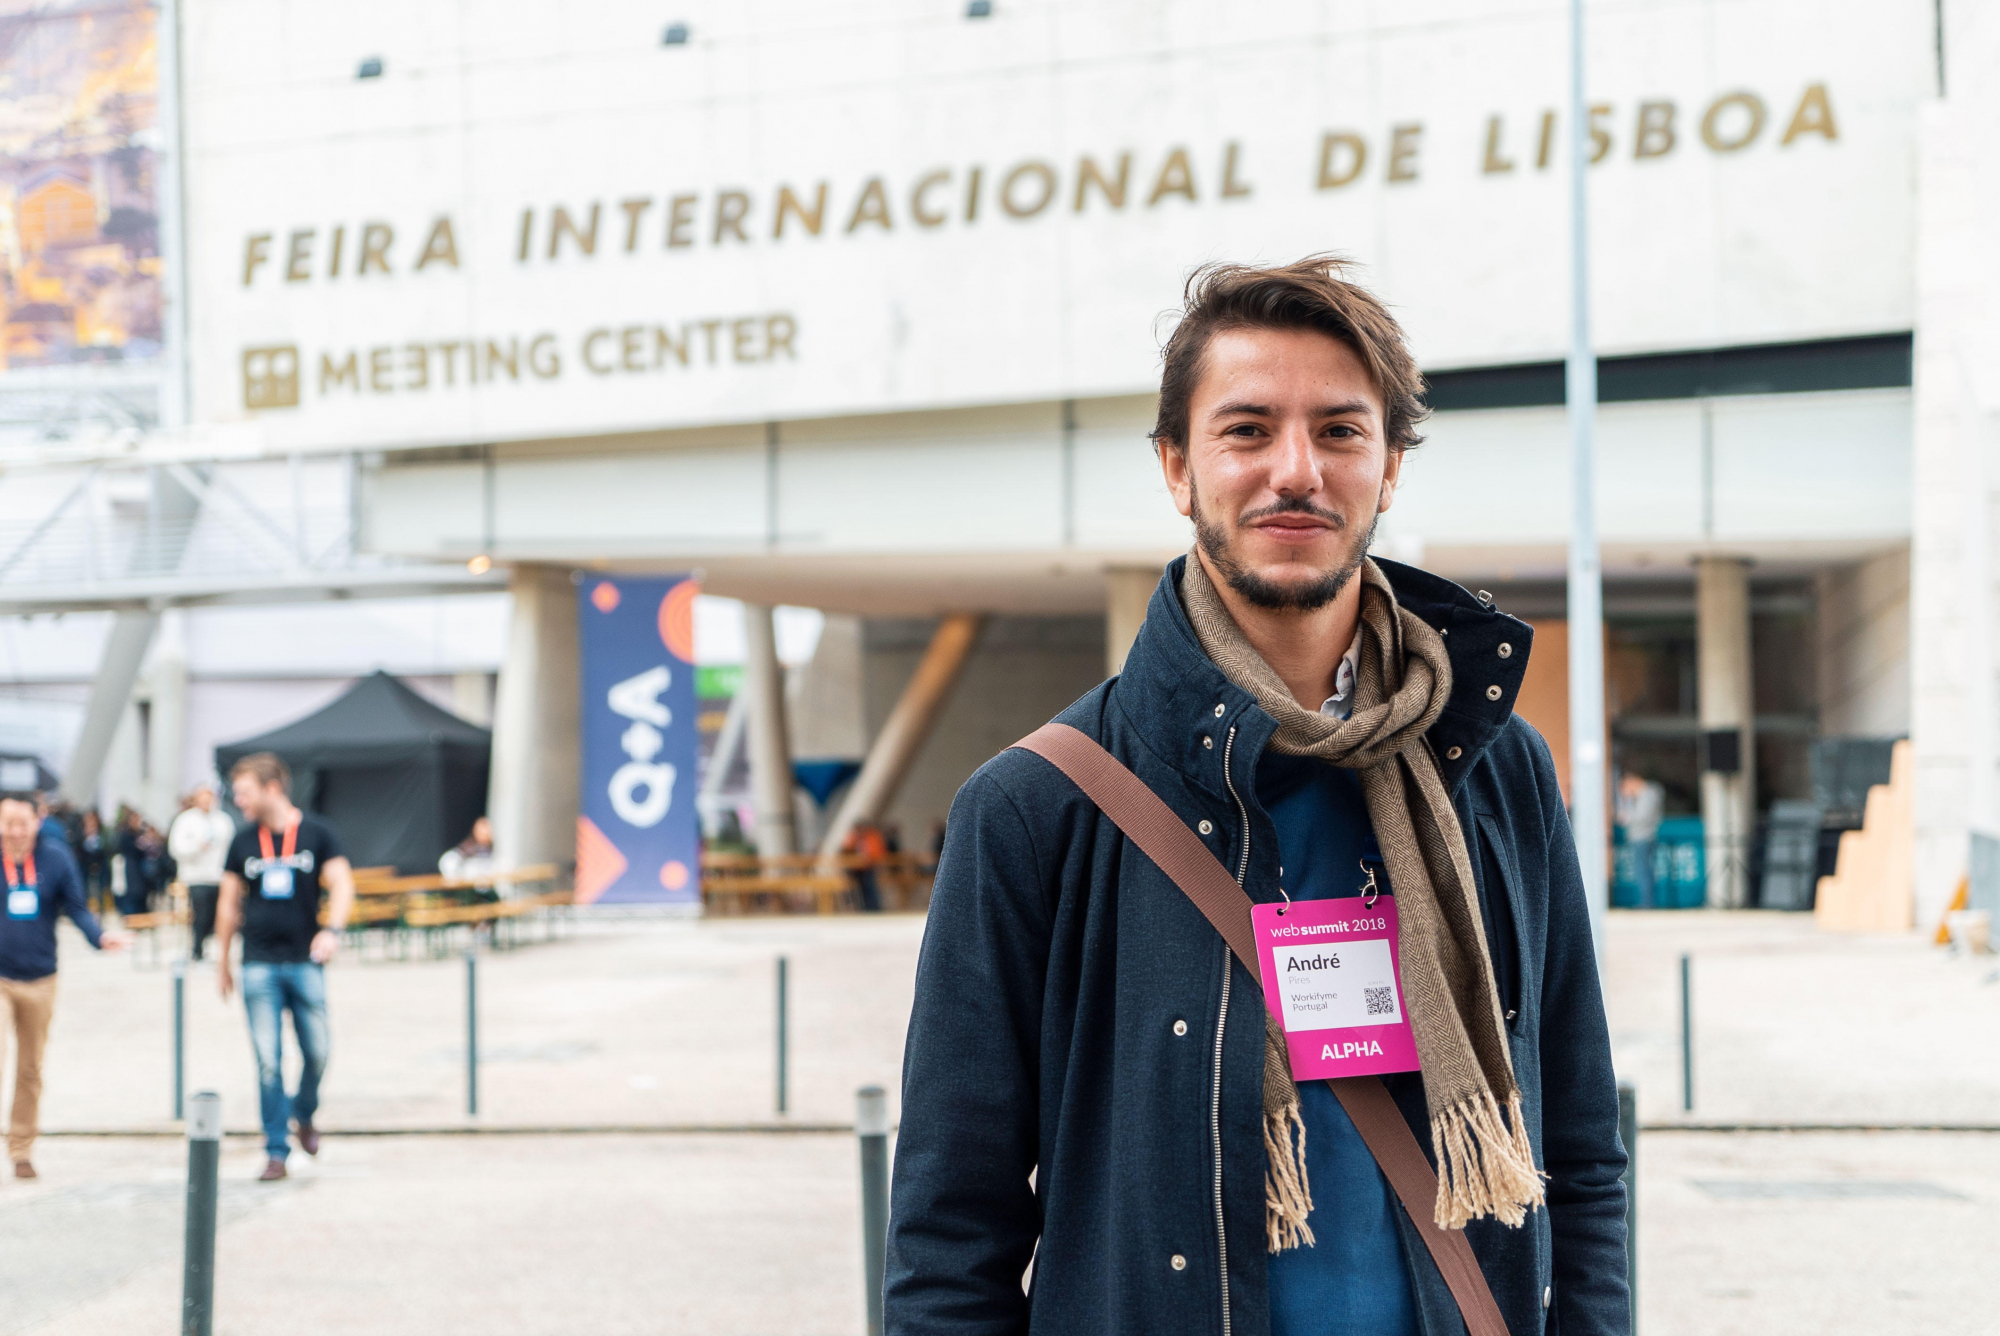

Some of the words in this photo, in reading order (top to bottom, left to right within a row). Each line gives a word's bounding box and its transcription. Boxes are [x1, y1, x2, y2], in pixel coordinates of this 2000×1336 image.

[243, 214, 460, 286] FEIRA
[517, 139, 1254, 263] INTERNACIONAL
[1315, 123, 1424, 190] DE
[1481, 83, 1839, 175] LISBOA
[580, 313, 799, 376] CENTER
[1352, 917, 1387, 932] 2018
[1287, 953, 1341, 972] André
[1288, 976, 1311, 985] Pires
[1291, 992, 1338, 1002] Workifyme
[1292, 1001, 1328, 1012] Portugal
[1321, 1040, 1383, 1060] ALPHA
